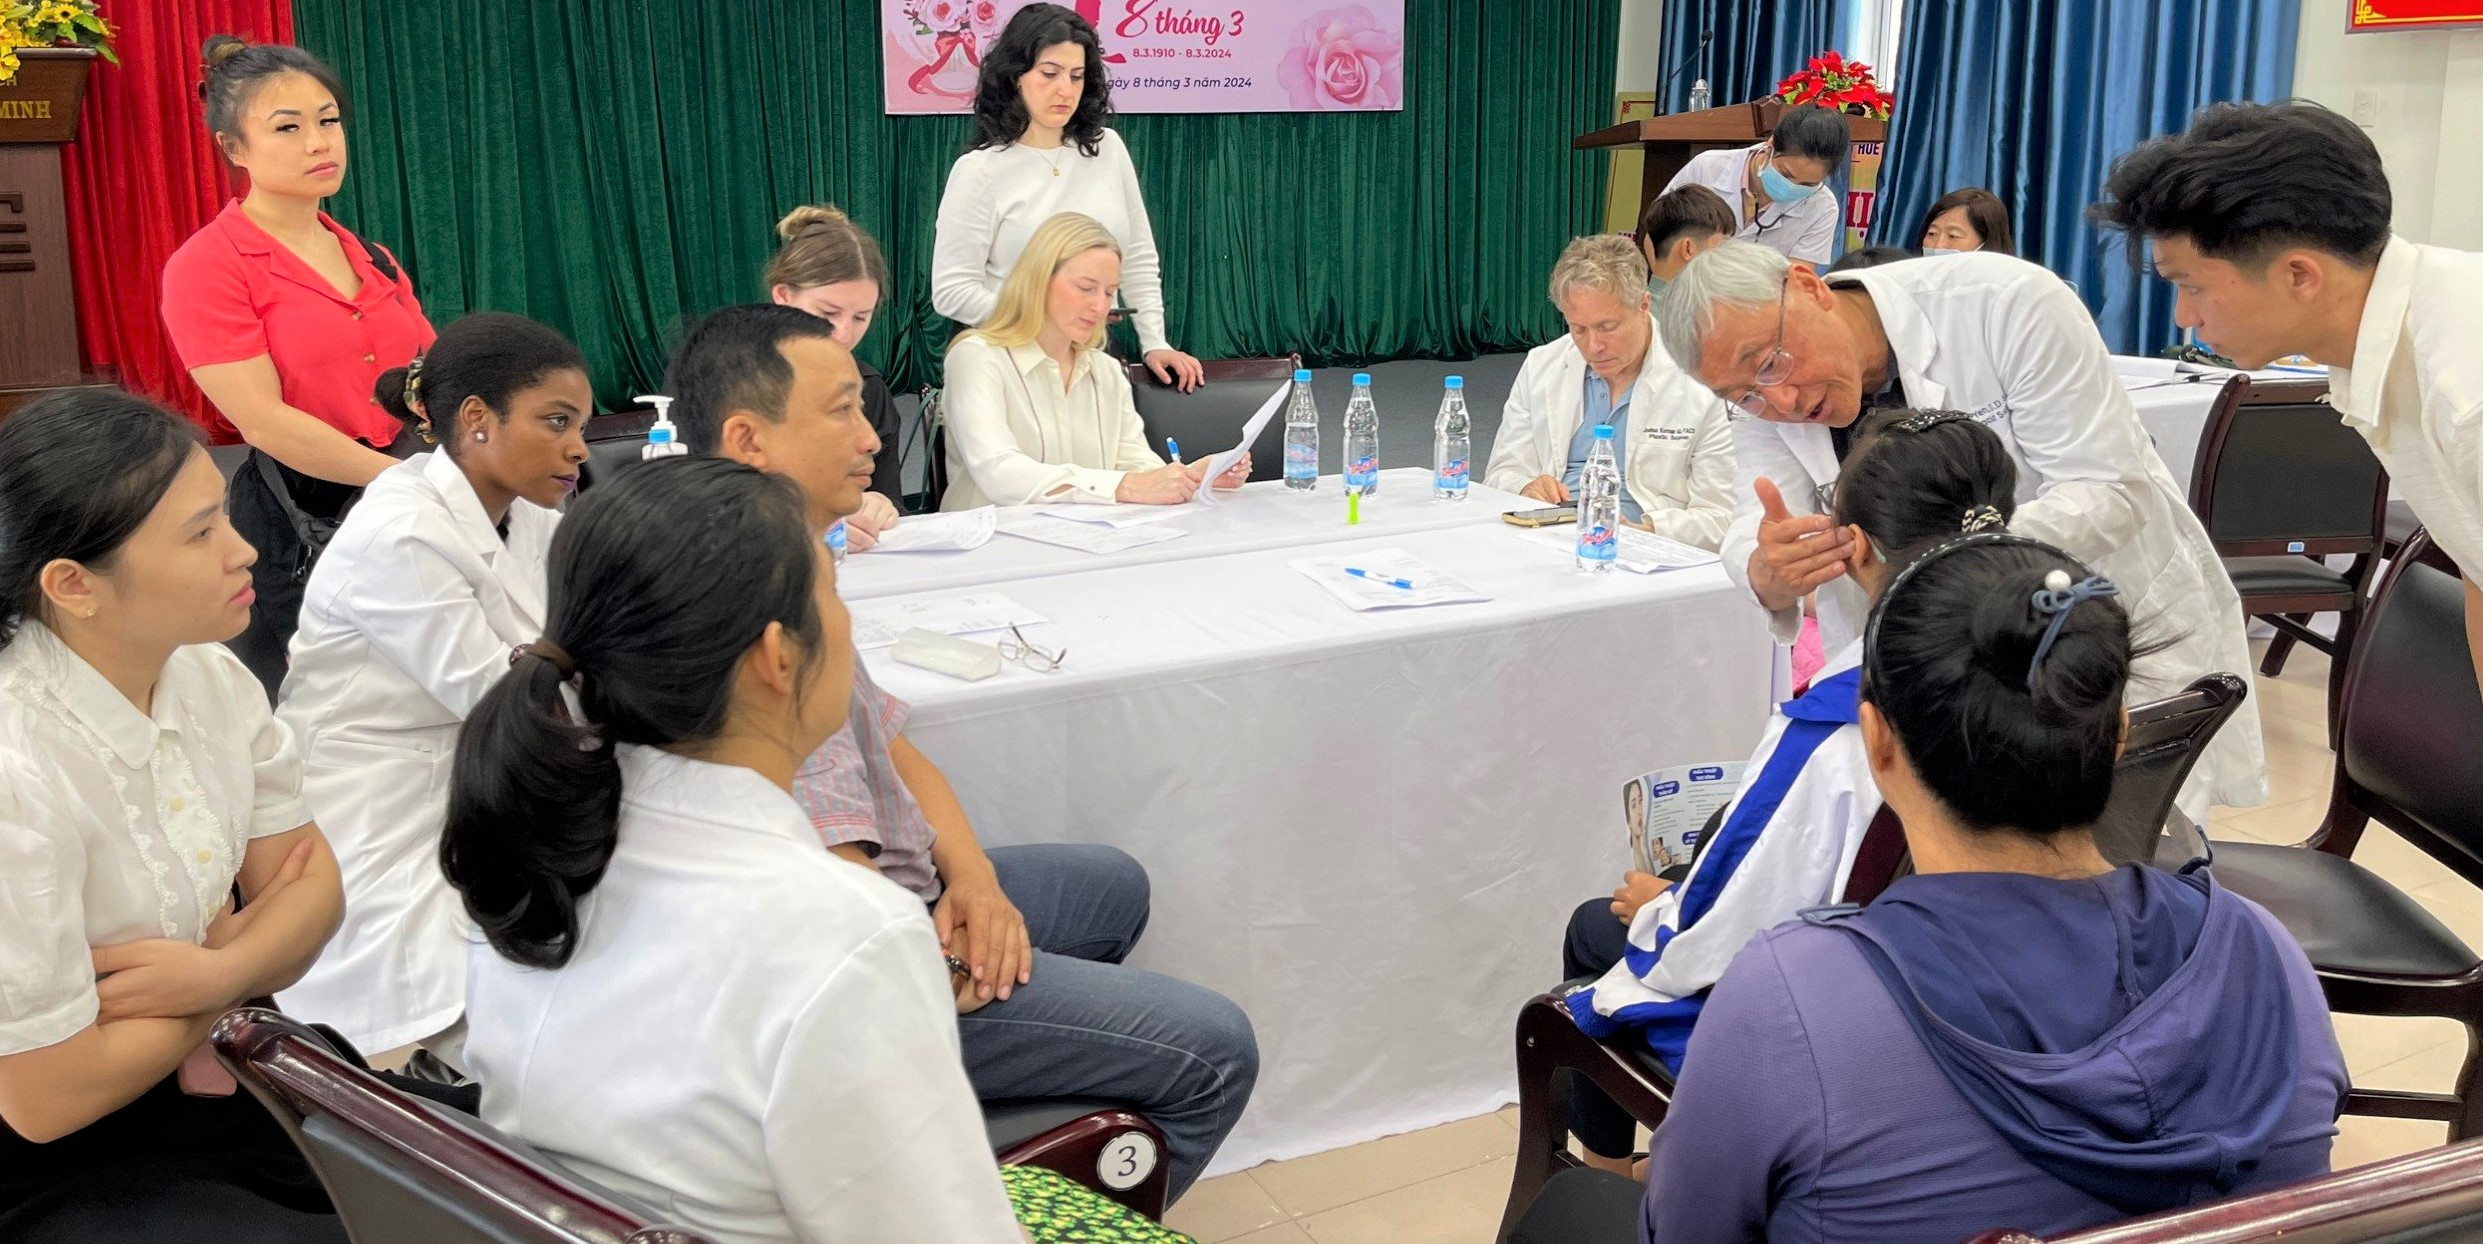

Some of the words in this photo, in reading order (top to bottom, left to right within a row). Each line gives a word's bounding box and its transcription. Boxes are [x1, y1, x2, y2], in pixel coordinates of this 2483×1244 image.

[1155, 8, 1225, 45] tháng
[1228, 10, 1245, 36] 3
[1133, 48, 1175, 58] 8.3.1910
[1185, 48, 1232, 58] 8.3.2024
[1133, 77, 1141, 88] 8
[1144, 77, 1181, 90] tháng
[1183, 77, 1191, 88] 3
[1193, 77, 1221, 88] năm
[1223, 77, 1252, 88] 2024
[1118, 1145, 1137, 1177] 3
